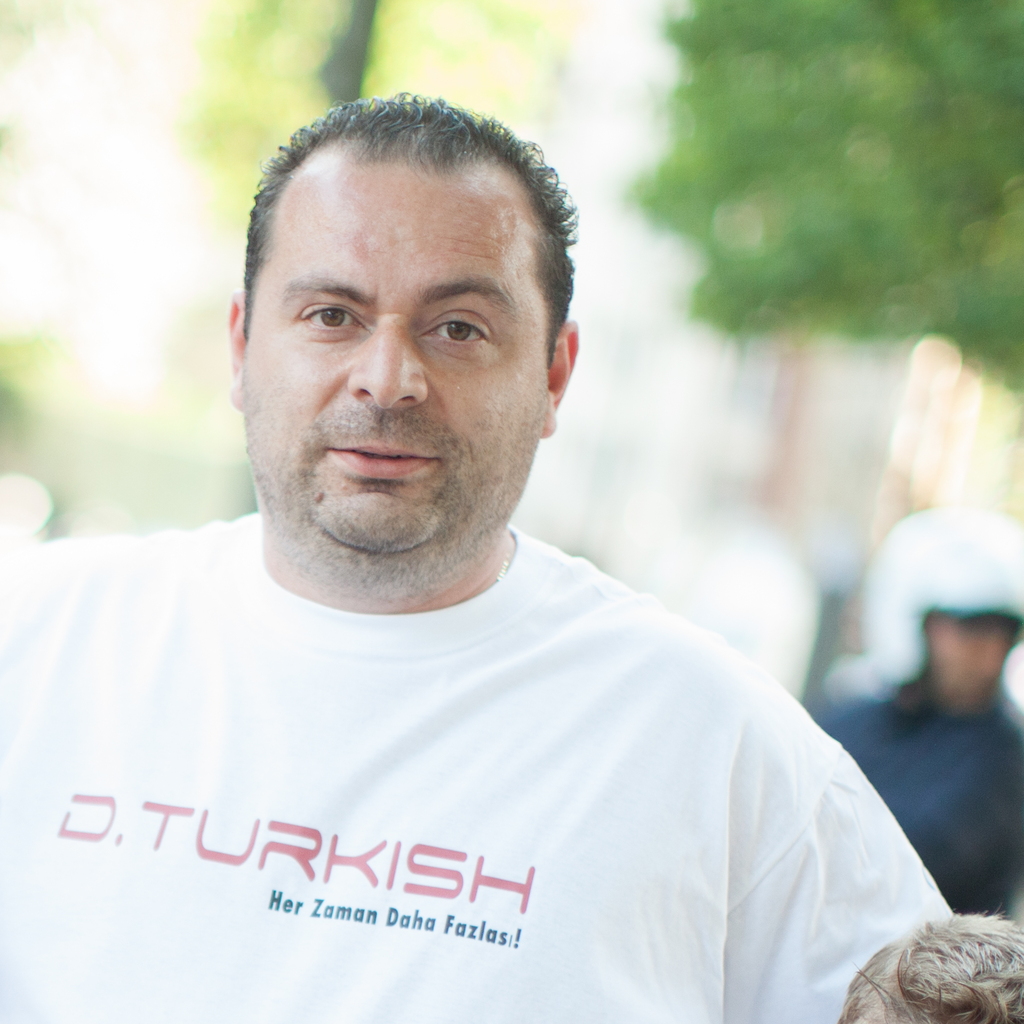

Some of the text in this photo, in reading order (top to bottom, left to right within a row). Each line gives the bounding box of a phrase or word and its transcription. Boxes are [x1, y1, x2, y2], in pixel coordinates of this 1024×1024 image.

[57, 794, 536, 914] D.TURKISH
[268, 889, 304, 915] Her
[310, 899, 378, 925] Zaman
[385, 907, 436, 932] Daha
